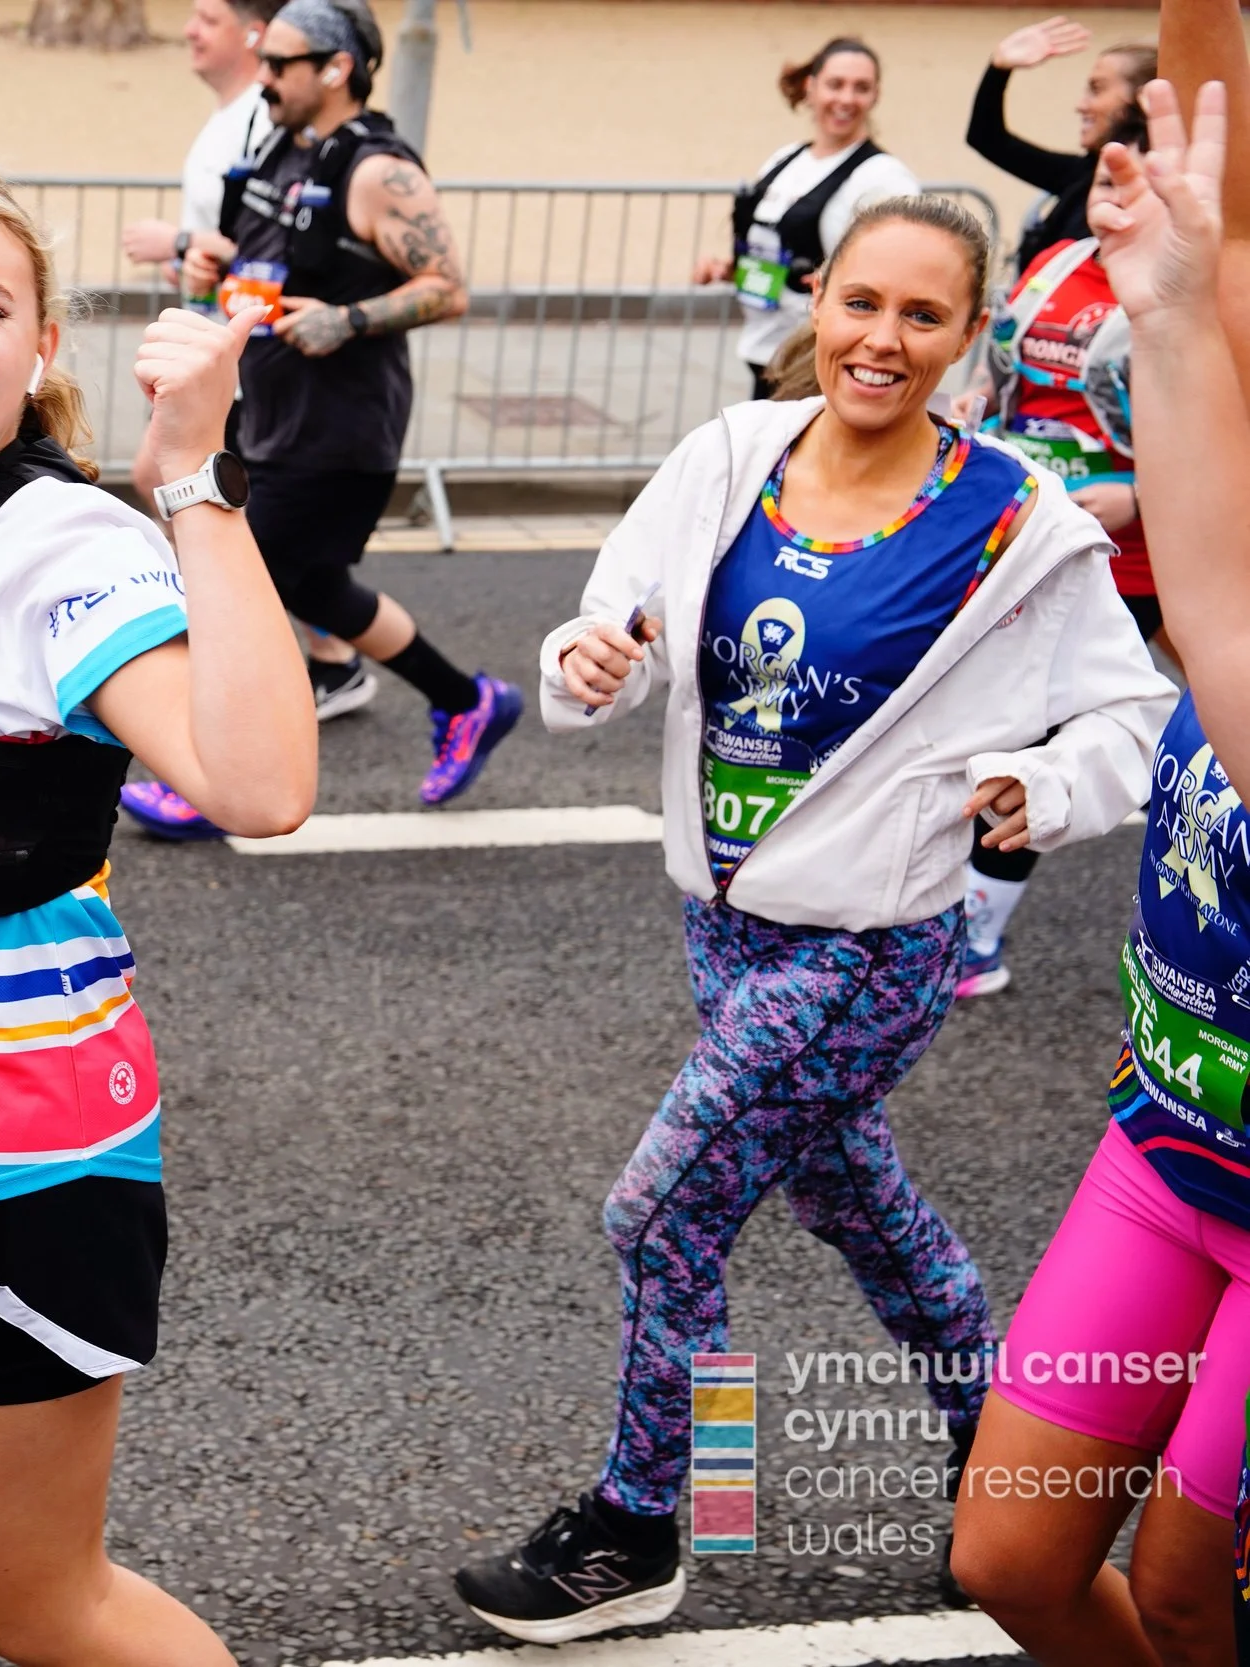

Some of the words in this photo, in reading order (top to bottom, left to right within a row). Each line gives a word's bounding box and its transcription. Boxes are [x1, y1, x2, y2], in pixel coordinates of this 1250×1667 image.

[774, 546, 833, 580] RCS
[717, 729, 782, 754] SWANSEA
[1156, 801, 1234, 890] ARMY
[1155, 861, 1178, 886] ONE
[1200, 904, 1240, 937] ALONE
[1123, 943, 1158, 1021] CHELSEA
[1153, 956, 1216, 1003] SWANSEA
[1165, 984, 1217, 1014] Marathon
[1130, 987, 1203, 1100] 7544
[1199, 1029, 1249, 1062] MORGAN'S
[1219, 1053, 1246, 1074] ARMY
